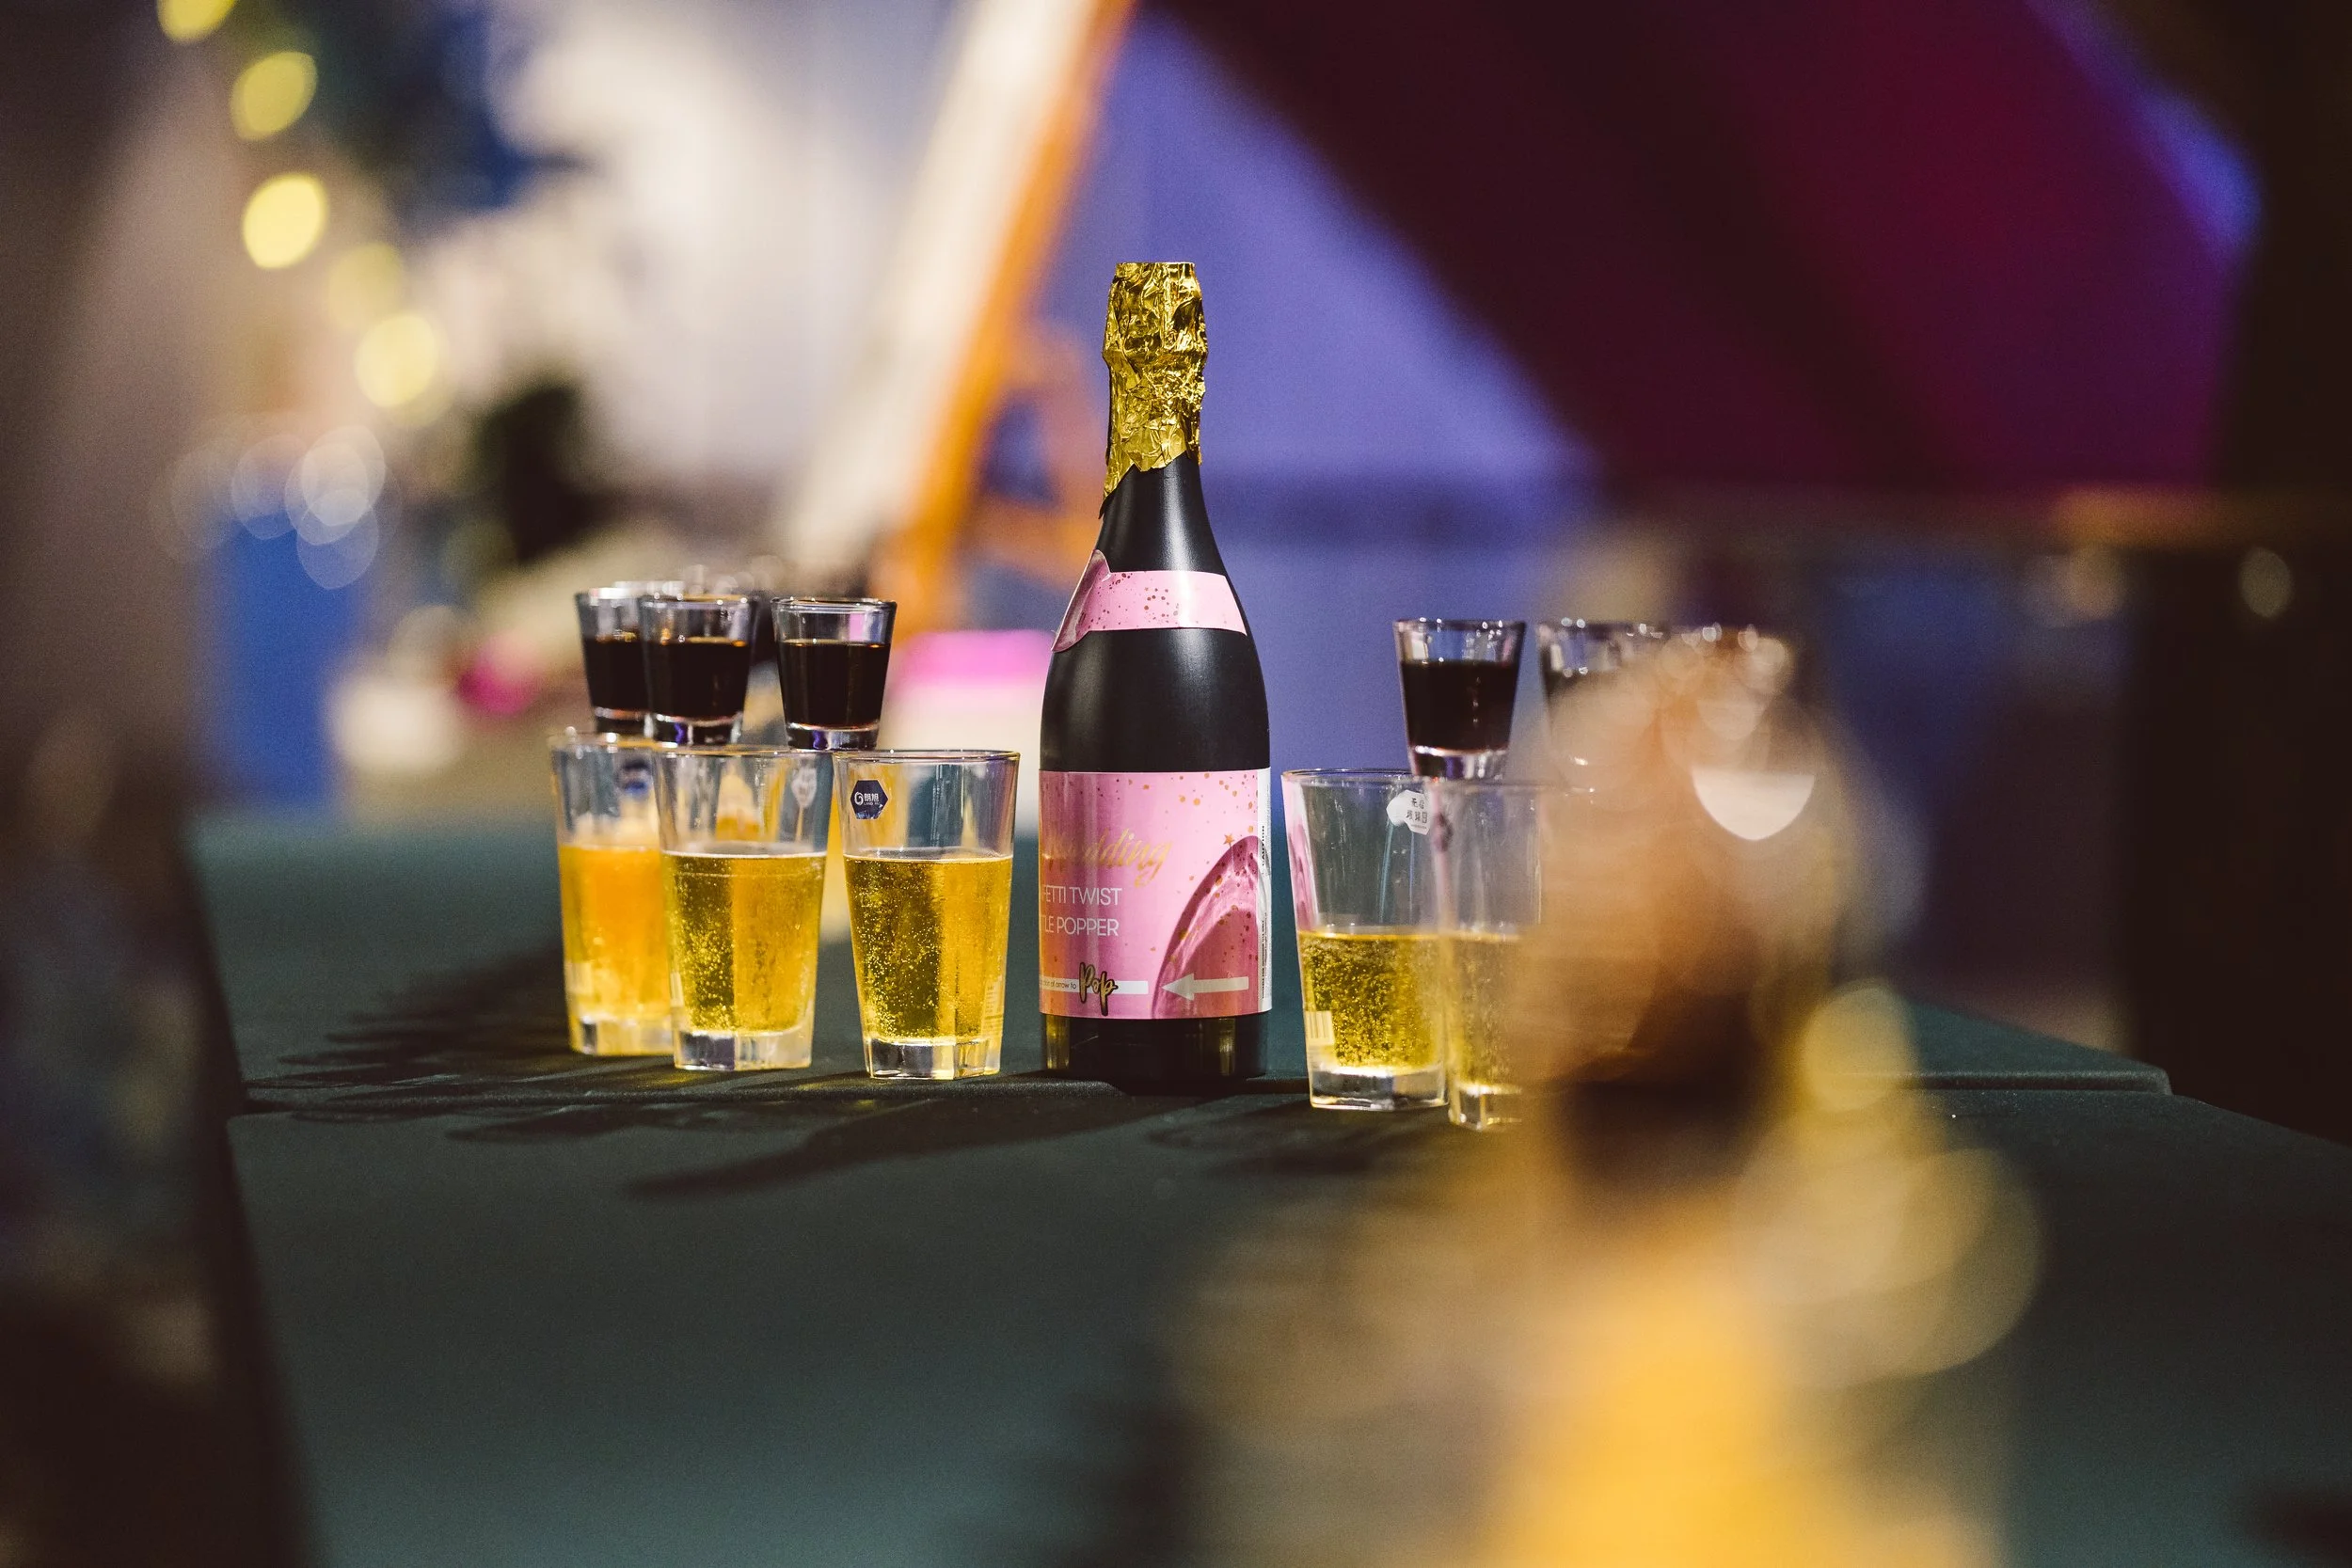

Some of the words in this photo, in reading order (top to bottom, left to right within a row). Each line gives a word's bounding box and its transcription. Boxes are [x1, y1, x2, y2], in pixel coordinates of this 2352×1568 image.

[1069, 887, 1122, 906] TWIST
[1057, 916, 1120, 937] POPPER
[1079, 961, 1119, 1017] Pop
